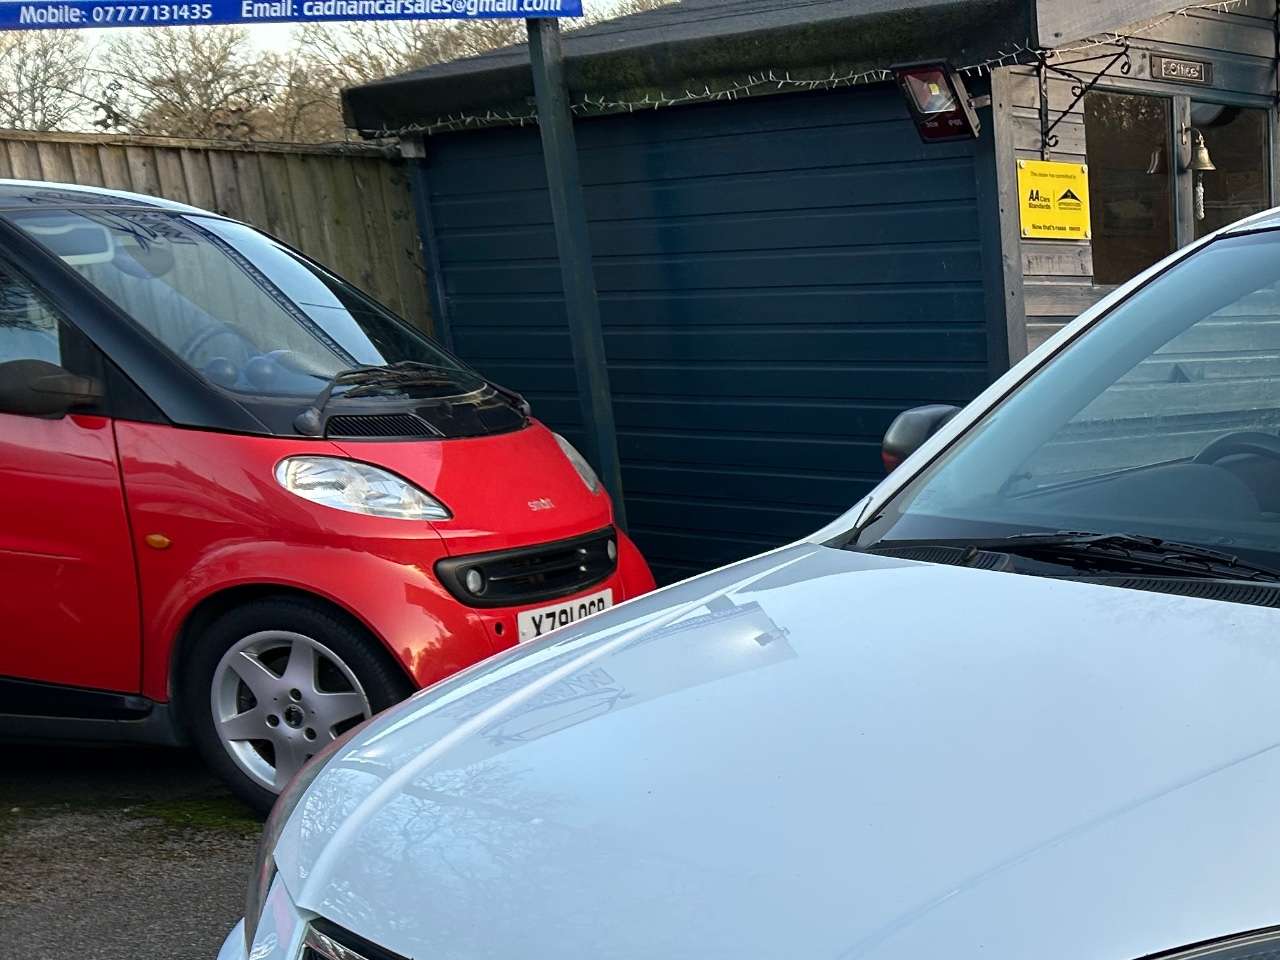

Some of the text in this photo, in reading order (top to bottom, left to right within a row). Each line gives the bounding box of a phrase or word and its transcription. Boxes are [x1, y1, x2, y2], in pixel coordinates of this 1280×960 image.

[19, 0, 562, 24] Mobile: 07777131435 Email: cadnamcarsales@gmail.com
[1029, 190, 1039, 201] AA
